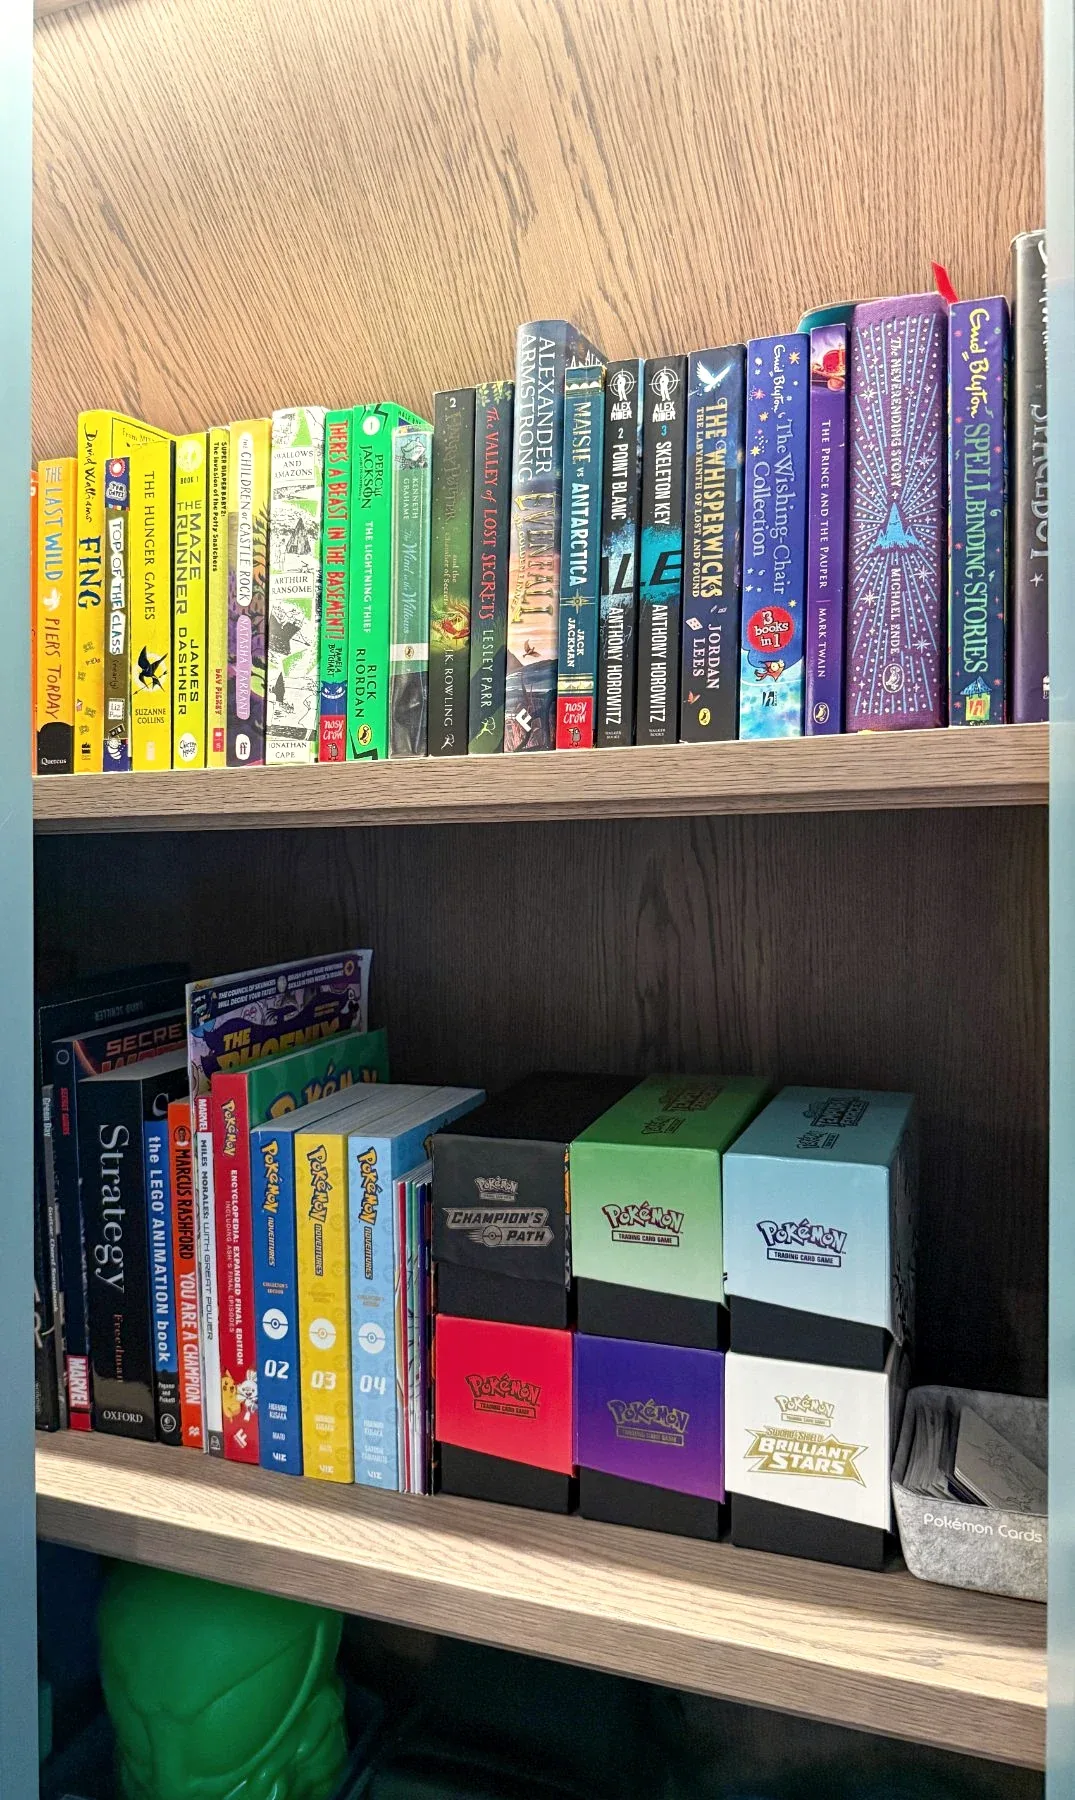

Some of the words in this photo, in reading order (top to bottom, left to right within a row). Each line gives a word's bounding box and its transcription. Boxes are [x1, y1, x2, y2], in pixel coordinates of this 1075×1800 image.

[890, 337, 900, 355] The
[485, 407, 500, 428] The
[518, 333, 536, 482] ARMSTRONG
[536, 337, 556, 474] ALEXANDER
[696, 407, 704, 430] THE
[705, 398, 728, 440] THE
[890, 358, 902, 446] NEVERENDING
[84, 423, 98, 465] David
[328, 420, 349, 464] THERE'S
[572, 401, 592, 464] MAISIE
[618, 428, 624, 439] 2
[661, 426, 667, 436] 3
[776, 418, 792, 454] The
[821, 420, 831, 443] THE
[46, 466, 62, 482] THE
[328, 468, 344, 478] A
[359, 445, 374, 510] JACKSON
[374, 454, 384, 497] PERCY
[484, 431, 498, 486] VALLEY
[612, 444, 628, 478] POINT
[655, 441, 672, 500] SKELETON
[695, 432, 704, 490] LABYRINTH
[820, 448, 830, 489] PRINCE
[890, 448, 902, 487] STORY
[84, 467, 97, 522] Walliams
[144, 471, 154, 498] THE
[240, 452, 252, 510] CHILDREN
[481, 489, 496, 504] of
[694, 492, 702, 507] OF
[45, 488, 63, 527] LAST
[177, 500, 202, 510] THE
[328, 482, 348, 520] BEAST
[611, 482, 626, 520] BLANC
[654, 501, 671, 525] KEY
[701, 440, 726, 598] WHISPERWICKS
[752, 461, 772, 557] Collection
[820, 494, 829, 517] AND
[112, 522, 122, 553] TOP
[144, 506, 155, 566] HUNGER
[327, 528, 346, 539] IN
[364, 522, 374, 540] THE
[482, 508, 496, 547] LOST
[569, 483, 590, 586] ANTARCTICA
[694, 508, 702, 534] LOST
[770, 453, 797, 594] Wishing-Chair
[820, 522, 829, 542] THE
[45, 534, 63, 580] WILD
[176, 514, 188, 614] RUNNER
[190, 513, 202, 580] MAZE
[240, 522, 250, 568] CASTLE
[327, 546, 347, 566] THE
[511, 491, 556, 623] EVENFALL
[694, 537, 702, 558] AND
[78, 536, 102, 610] FING
[112, 558, 122, 576] OF
[239, 570, 250, 600] ROCK
[274, 576, 308, 584] ARTHUR
[363, 544, 374, 602] LIGHTNING
[692, 562, 700, 598] FOUND
[819, 548, 828, 589] PAUPER
[111, 583, 122, 610] THE
[144, 571, 156, 620] GAMES
[272, 585, 312, 594] RANSOME
[326, 572, 346, 640] BASEMENT!
[480, 554, 496, 620] SECRETS
[890, 568, 900, 620] MICHAEL
[46, 618, 60, 657] PIERS
[111, 614, 121, 656] CLASS
[362, 605, 372, 632] THIEF
[608, 607, 624, 662] ANTHONY
[651, 604, 668, 658] ANTHONY
[754, 622, 789, 636] books
[762, 610, 773, 626] 3
[818, 608, 828, 638] MARK
[963, 582, 988, 673] STORIES
[238, 618, 248, 666] NATASHA
[444, 648, 454, 666] J.K.
[482, 630, 494, 672] LESLEY
[567, 618, 576, 668] JACKMAN
[692, 638, 706, 676] LEES
[706, 624, 721, 689] JORDAN
[760, 637, 772, 647] in
[774, 634, 781, 648] 1
[890, 625, 900, 654] ENDE
[178, 628, 188, 715] DASHNER
[190, 639, 199, 702] JAMES
[327, 644, 336, 678] BUTCHART
[334, 647, 342, 673] PAMELA
[817, 642, 826, 678] TWAIN
[46, 664, 62, 719] TORDAY
[238, 668, 248, 716] FARRANT
[355, 648, 366, 718] RIORDAN
[367, 664, 376, 700] RICK
[444, 668, 454, 728] ROWLING
[480, 678, 492, 708] PARR
[606, 664, 622, 725] HOROWITZ
[650, 662, 667, 722] HOROWITZ
[135, 708, 166, 716] SUZANNE
[223, 1028, 252, 1050] THE
[198, 1098, 208, 1131] MARVEL
[148, 1136, 161, 1163] the
[200, 1140, 208, 1166] MILES
[150, 1170, 164, 1212] LEGO
[176, 1150, 192, 1196] MARCUS
[94, 1124, 130, 1294] Strategy
[230, 1170, 240, 1242] ENCYCLOPEDIA:
[450, 1210, 545, 1225] CHAMPION'S
[178, 1200, 194, 1260] RASHFORD
[202, 1222, 210, 1250] WITH
[268, 1216, 276, 1266] ADVENTURES
[506, 1229, 546, 1242] PATH
[152, 1218, 169, 1314] ANIMATION
[314, 1224, 324, 1276] ADVENTURES
[364, 1226, 374, 1280] ADVENTURES
[774, 1252, 799, 1260] TRADING
[800, 1254, 815, 1262] CARD
[817, 1256, 834, 1264] GAME
[179, 1272, 196, 1299] YOU
[204, 1254, 212, 1294] GREAT
[233, 1246, 241, 1294] EXPANDED
[180, 1302, 197, 1328] ARE
[206, 1297, 214, 1340] POWER
[234, 1298, 242, 1324] FINAL
[156, 1322, 170, 1362] book
[182, 1332, 198, 1342] A
[236, 1328, 244, 1365] EDITION
[68, 1357, 88, 1406] MARVEL
[182, 1344, 200, 1404] CHAMPION
[264, 1359, 290, 1379] 02
[312, 1371, 336, 1390] 03
[360, 1374, 386, 1395] 04
[103, 1410, 143, 1423] OXFORD
[758, 1437, 853, 1460] BRILLIANT
[769, 1452, 846, 1474] STARS
[924, 1512, 994, 1536] Pokémon
[998, 1524, 1043, 1543] Cards
